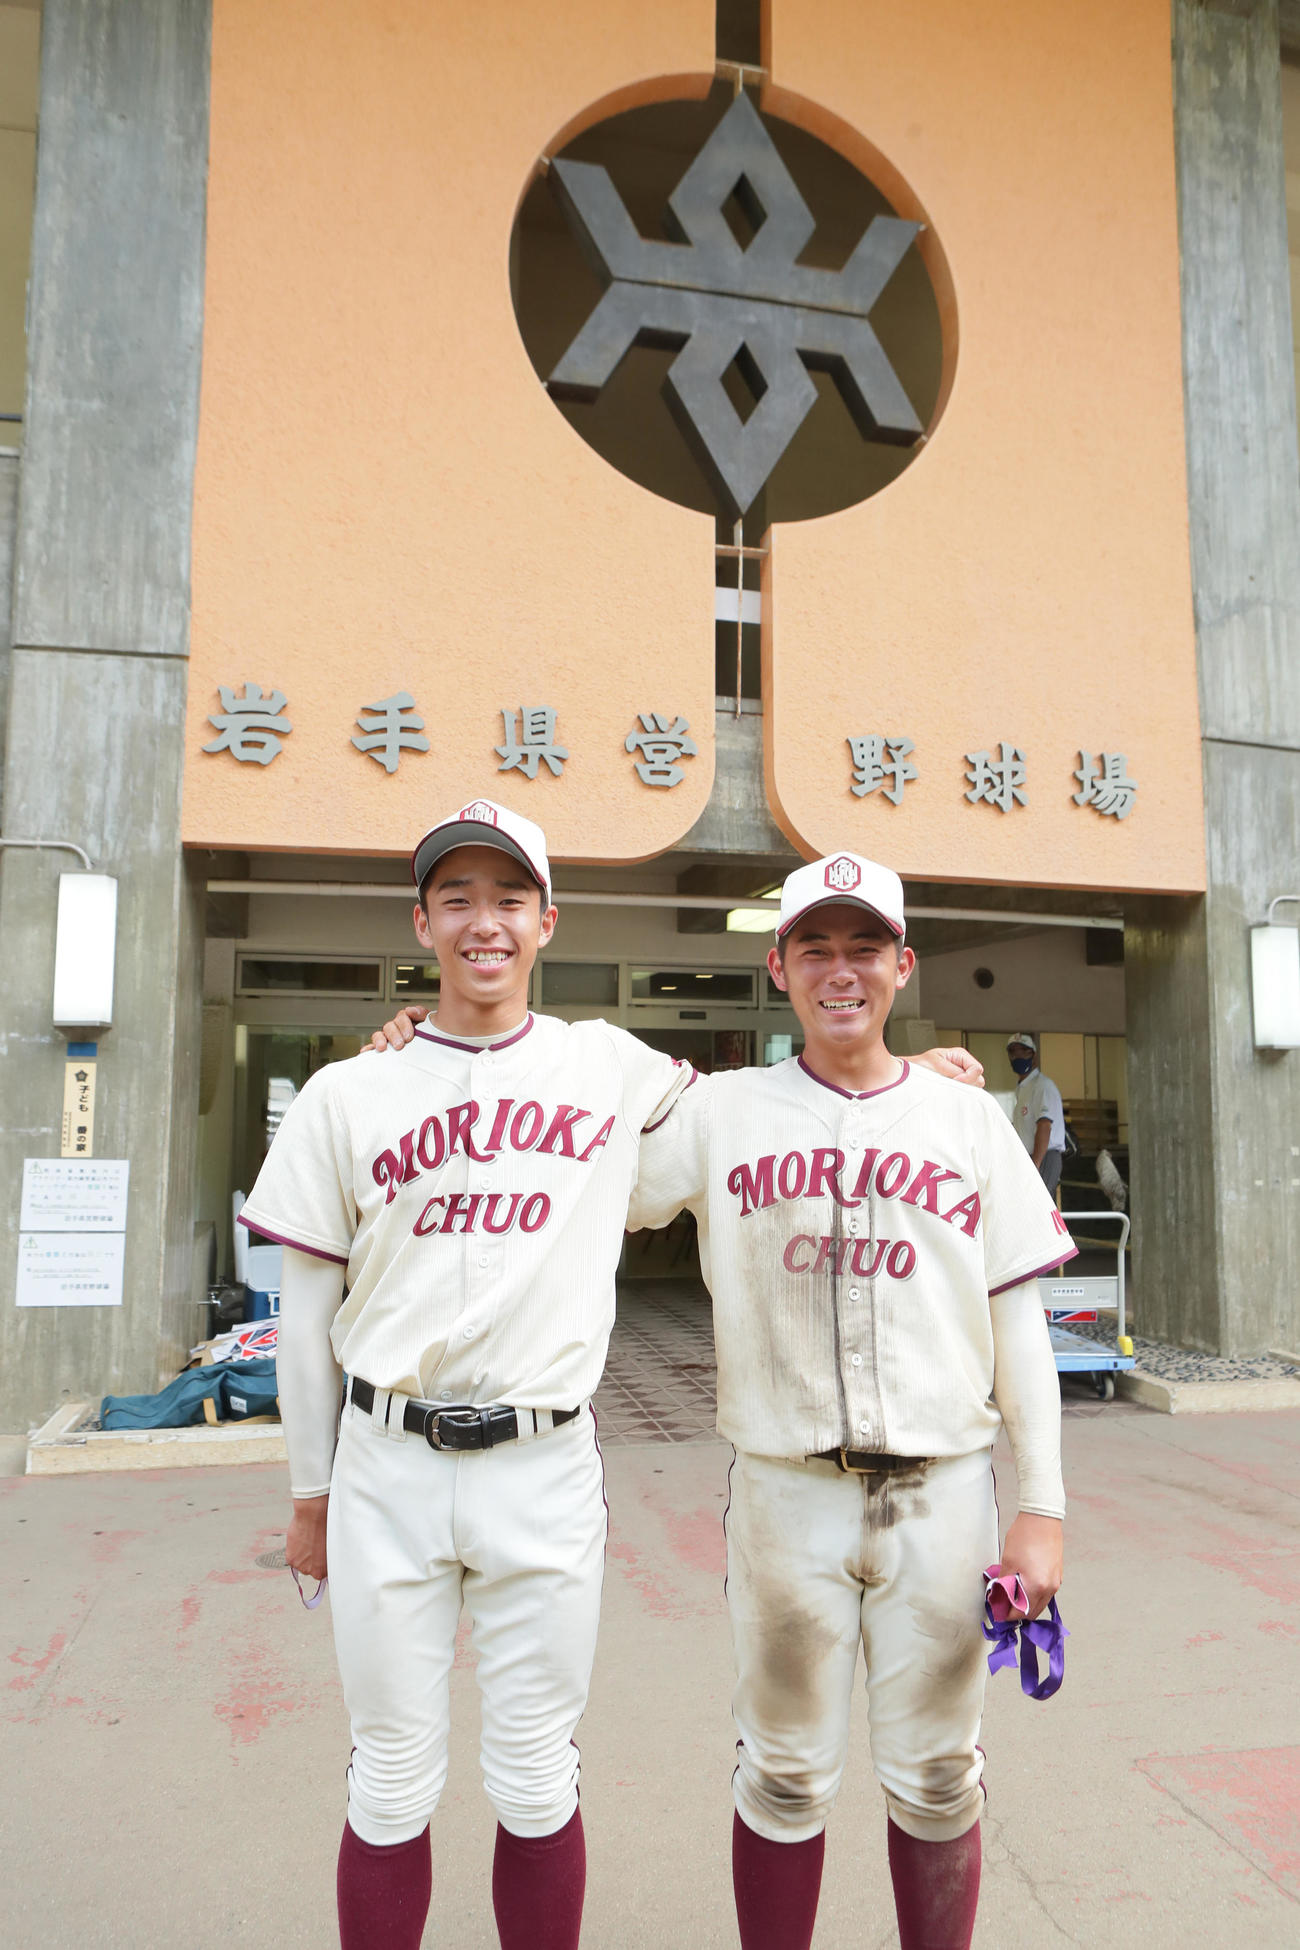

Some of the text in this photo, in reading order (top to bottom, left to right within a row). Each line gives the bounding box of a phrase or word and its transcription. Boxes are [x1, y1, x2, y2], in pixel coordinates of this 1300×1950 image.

[201, 682, 1139, 821] 岩手県営 野球場
[372, 1098, 616, 1205] MORIOKA
[728, 1148, 981, 1238] MORIOKA
[412, 1191, 552, 1237] CHUO
[783, 1234, 917, 1280] CHUO
